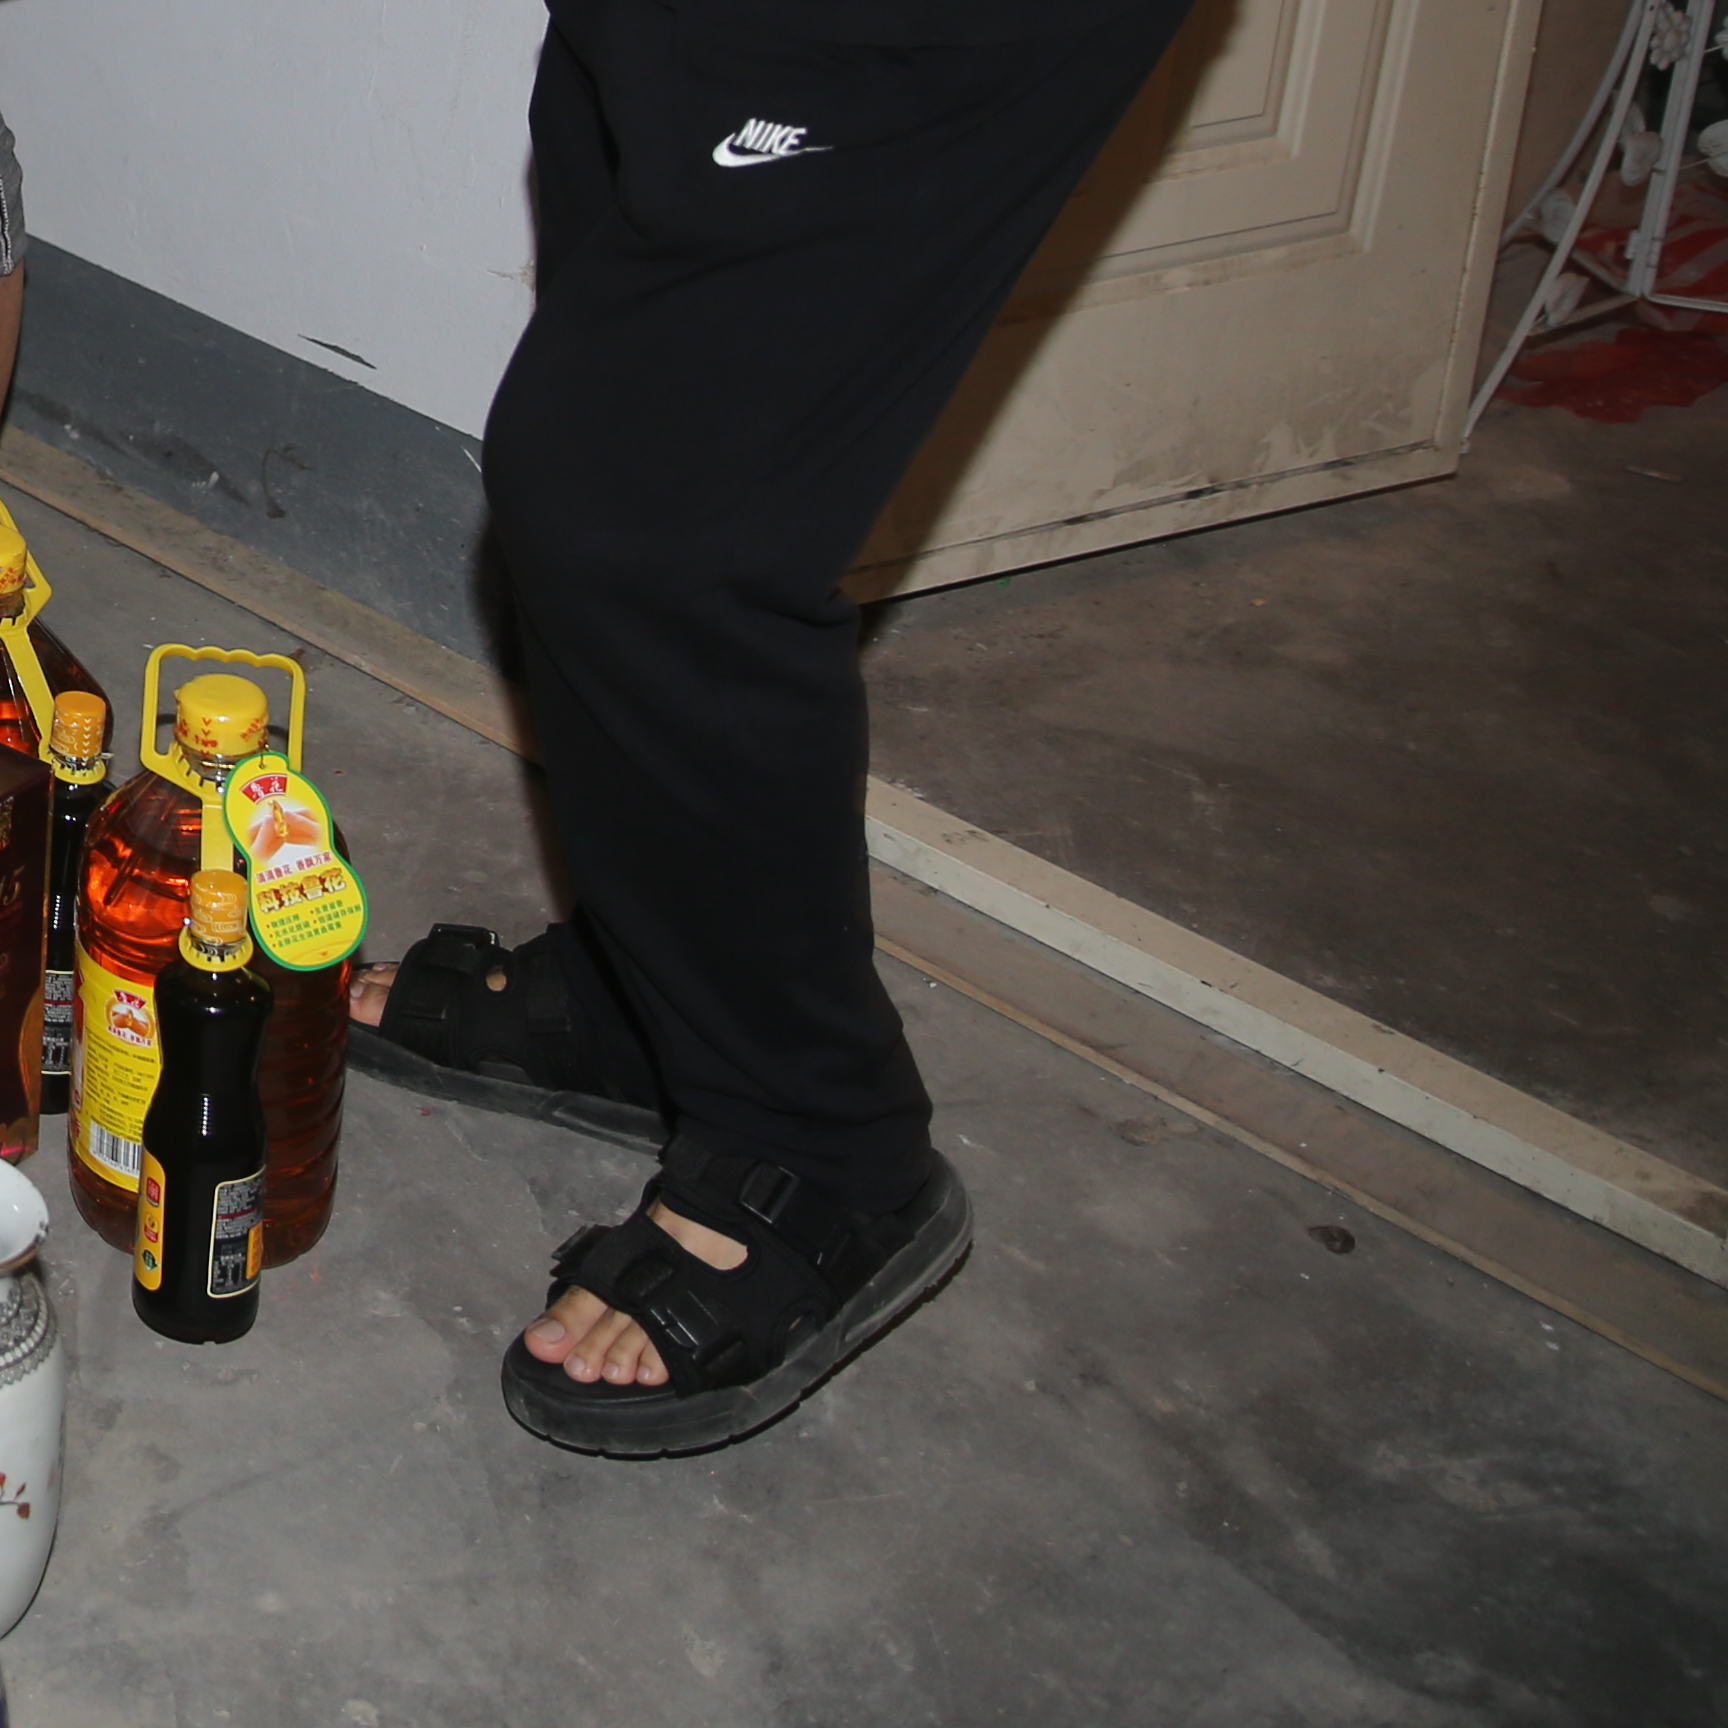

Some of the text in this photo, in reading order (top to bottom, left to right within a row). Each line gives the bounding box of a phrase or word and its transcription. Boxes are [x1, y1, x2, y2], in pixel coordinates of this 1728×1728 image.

[733, 118, 807, 154] NIKE
[256, 867, 347, 913] 科技鲁花
